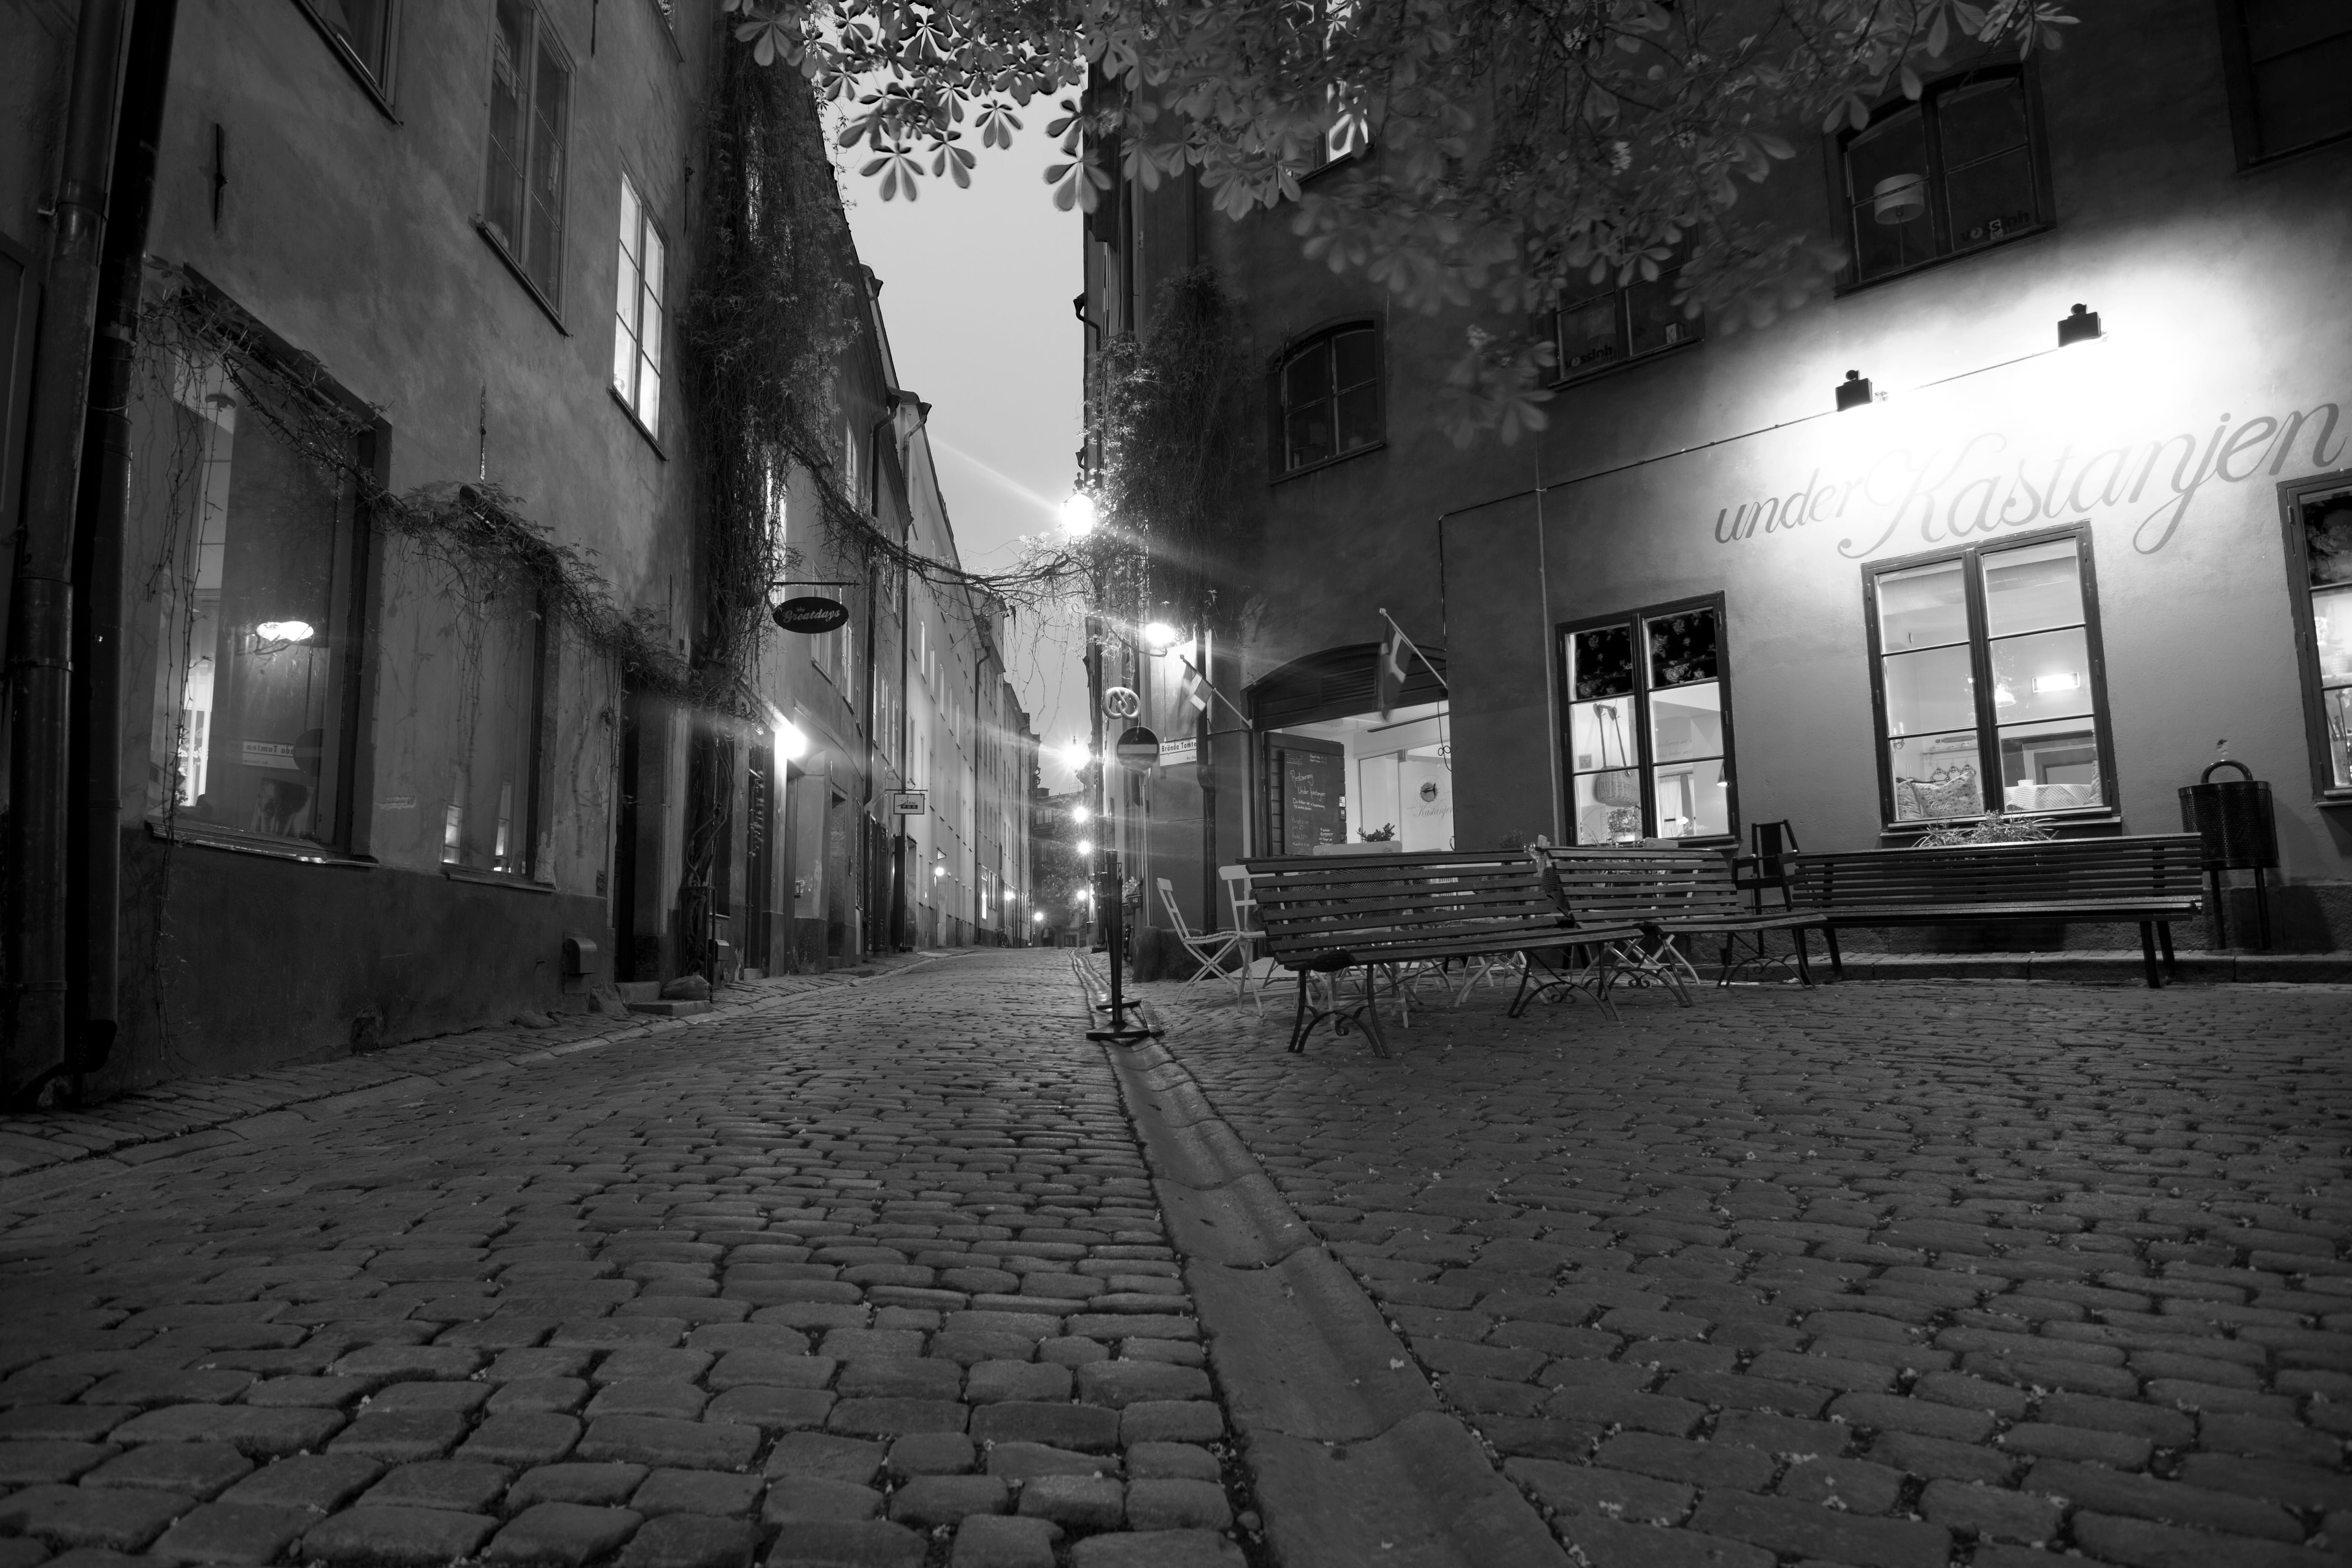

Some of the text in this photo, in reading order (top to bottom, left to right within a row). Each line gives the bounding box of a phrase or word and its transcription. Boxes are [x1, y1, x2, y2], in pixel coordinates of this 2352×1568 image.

[1715, 402, 2349, 559] under Kastanjen
[782, 608, 841, 623] Greatdays
[1162, 743, 1179, 752] Brända
[1928, 799, 1953, 813] Café
